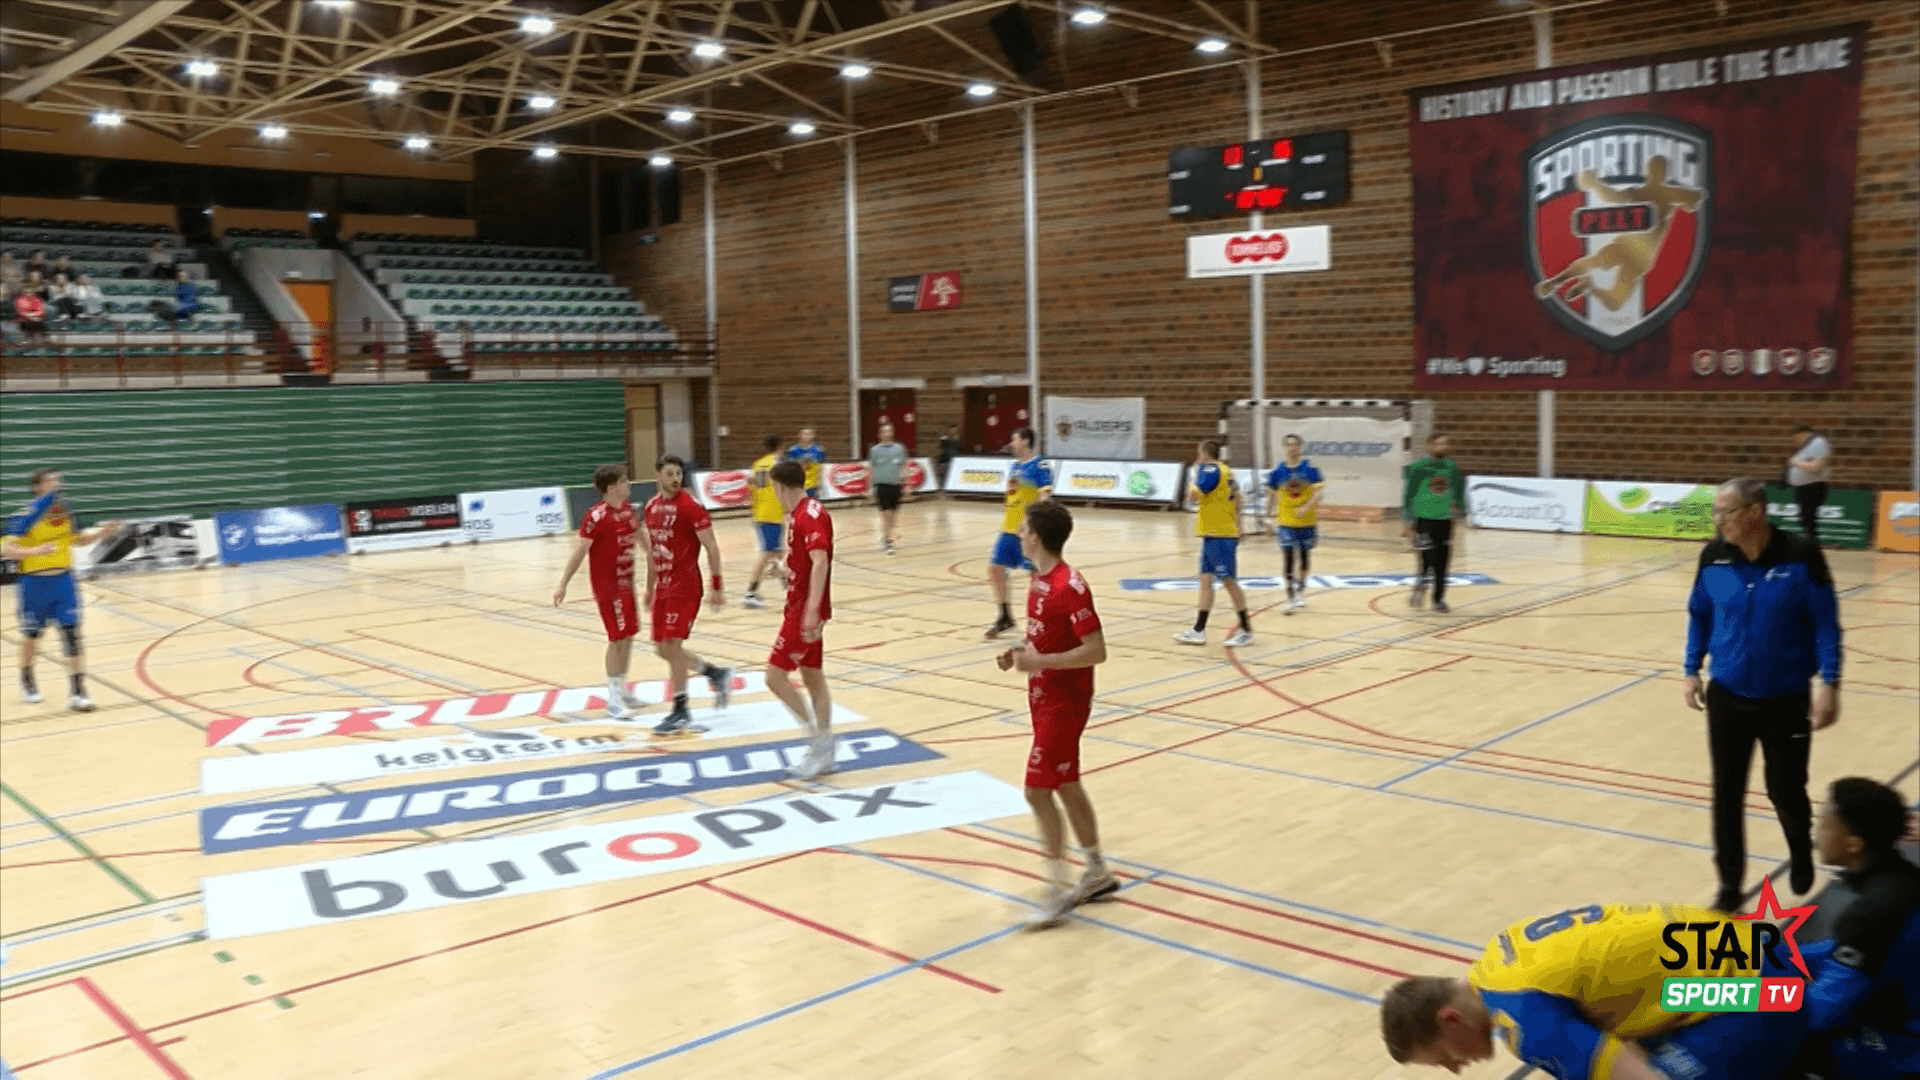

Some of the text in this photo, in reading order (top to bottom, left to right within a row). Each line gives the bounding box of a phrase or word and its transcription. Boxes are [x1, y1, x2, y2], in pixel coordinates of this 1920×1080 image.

[1420, 37, 1852, 122] HISTORY AND PASSION RULE THE GAME
[1533, 134, 1698, 200] SPORTING
[303, 786, 932, 918] buropix
